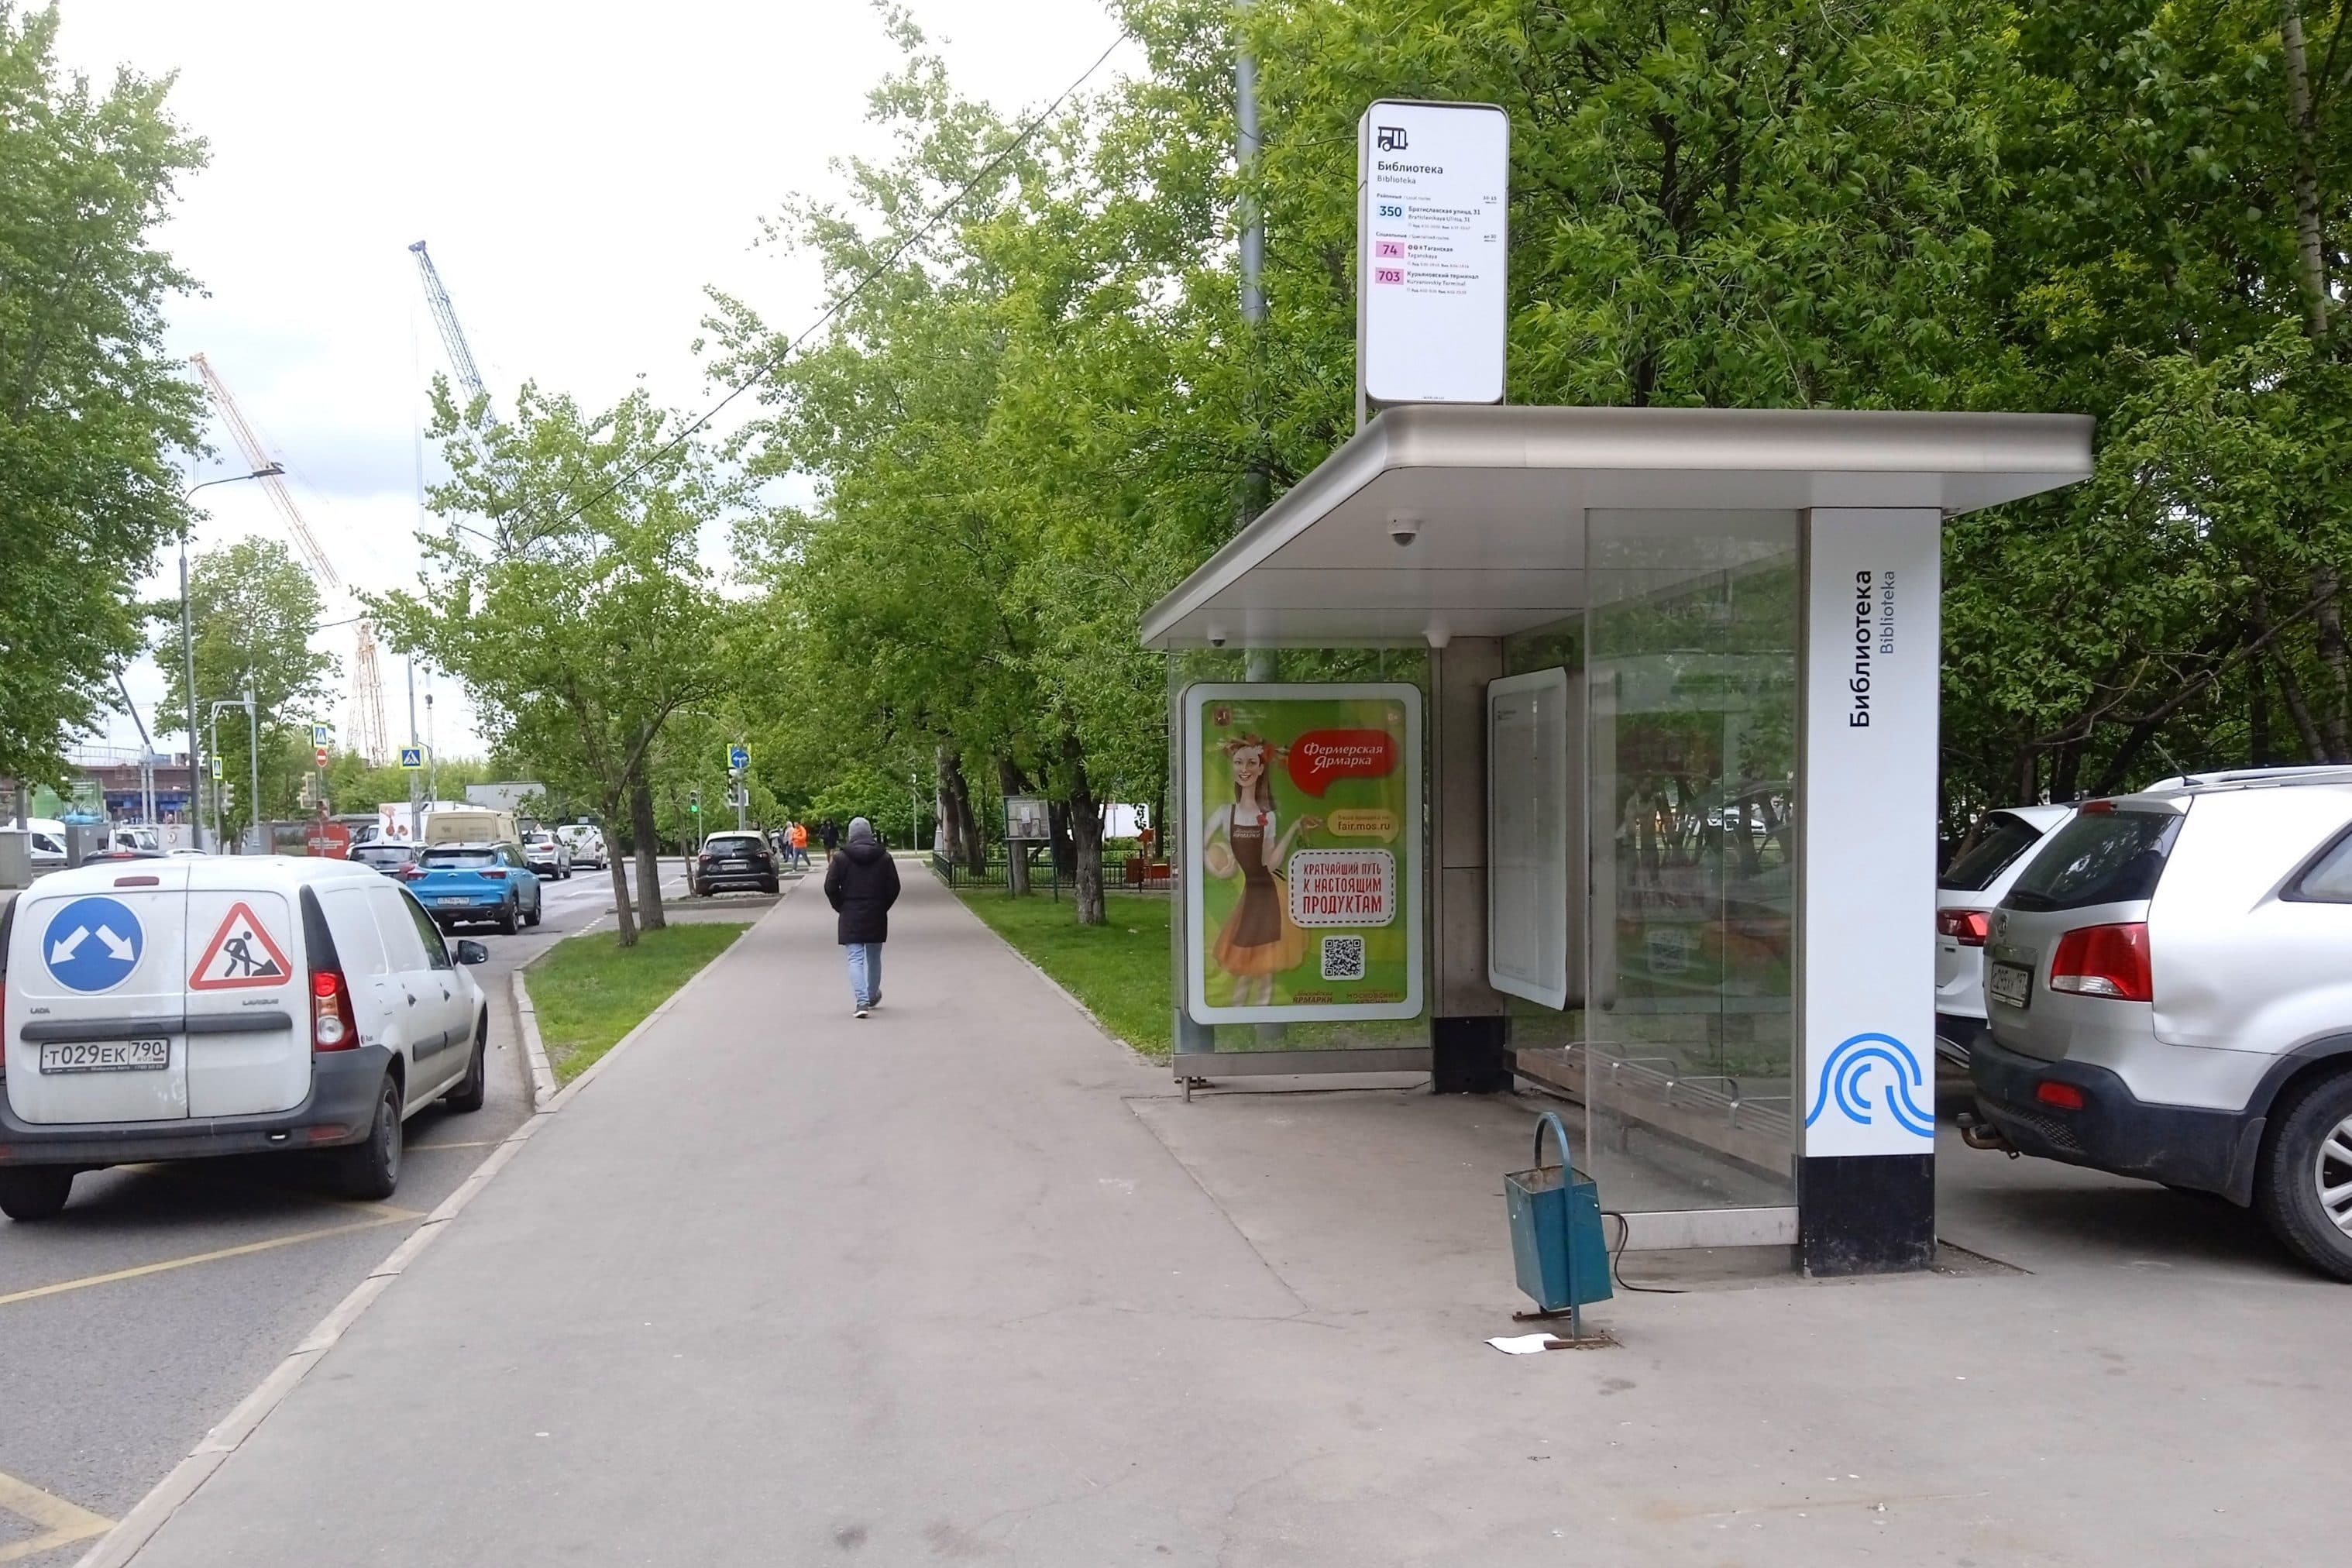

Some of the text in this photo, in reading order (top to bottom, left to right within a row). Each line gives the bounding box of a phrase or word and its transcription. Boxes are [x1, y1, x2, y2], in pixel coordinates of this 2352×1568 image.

[1377, 160, 1443, 174] Библиотека
[1377, 175, 1416, 184] Biblioteka
[1379, 205, 1402, 217] 350
[1383, 244, 1398, 255] 74
[1379, 271, 1400, 282] 703
[1880, 571, 1895, 654] Biblioteka
[1849, 571, 1871, 727] Библиотека
[1304, 742, 1383, 756] Фермерская
[1310, 755, 1372, 773] Ярмарка
[1338, 821, 1390, 830] fair.mos.ru
[1304, 862, 1381, 875] КРАТЧАЙШИЙ ПУТЬ
[1303, 878, 1381, 893] К НАСТОЯЩИМ
[1303, 895, 1381, 914] ПРОДУКТАМ
[50, 1041, 162, 1065] Т029ЕК 790
